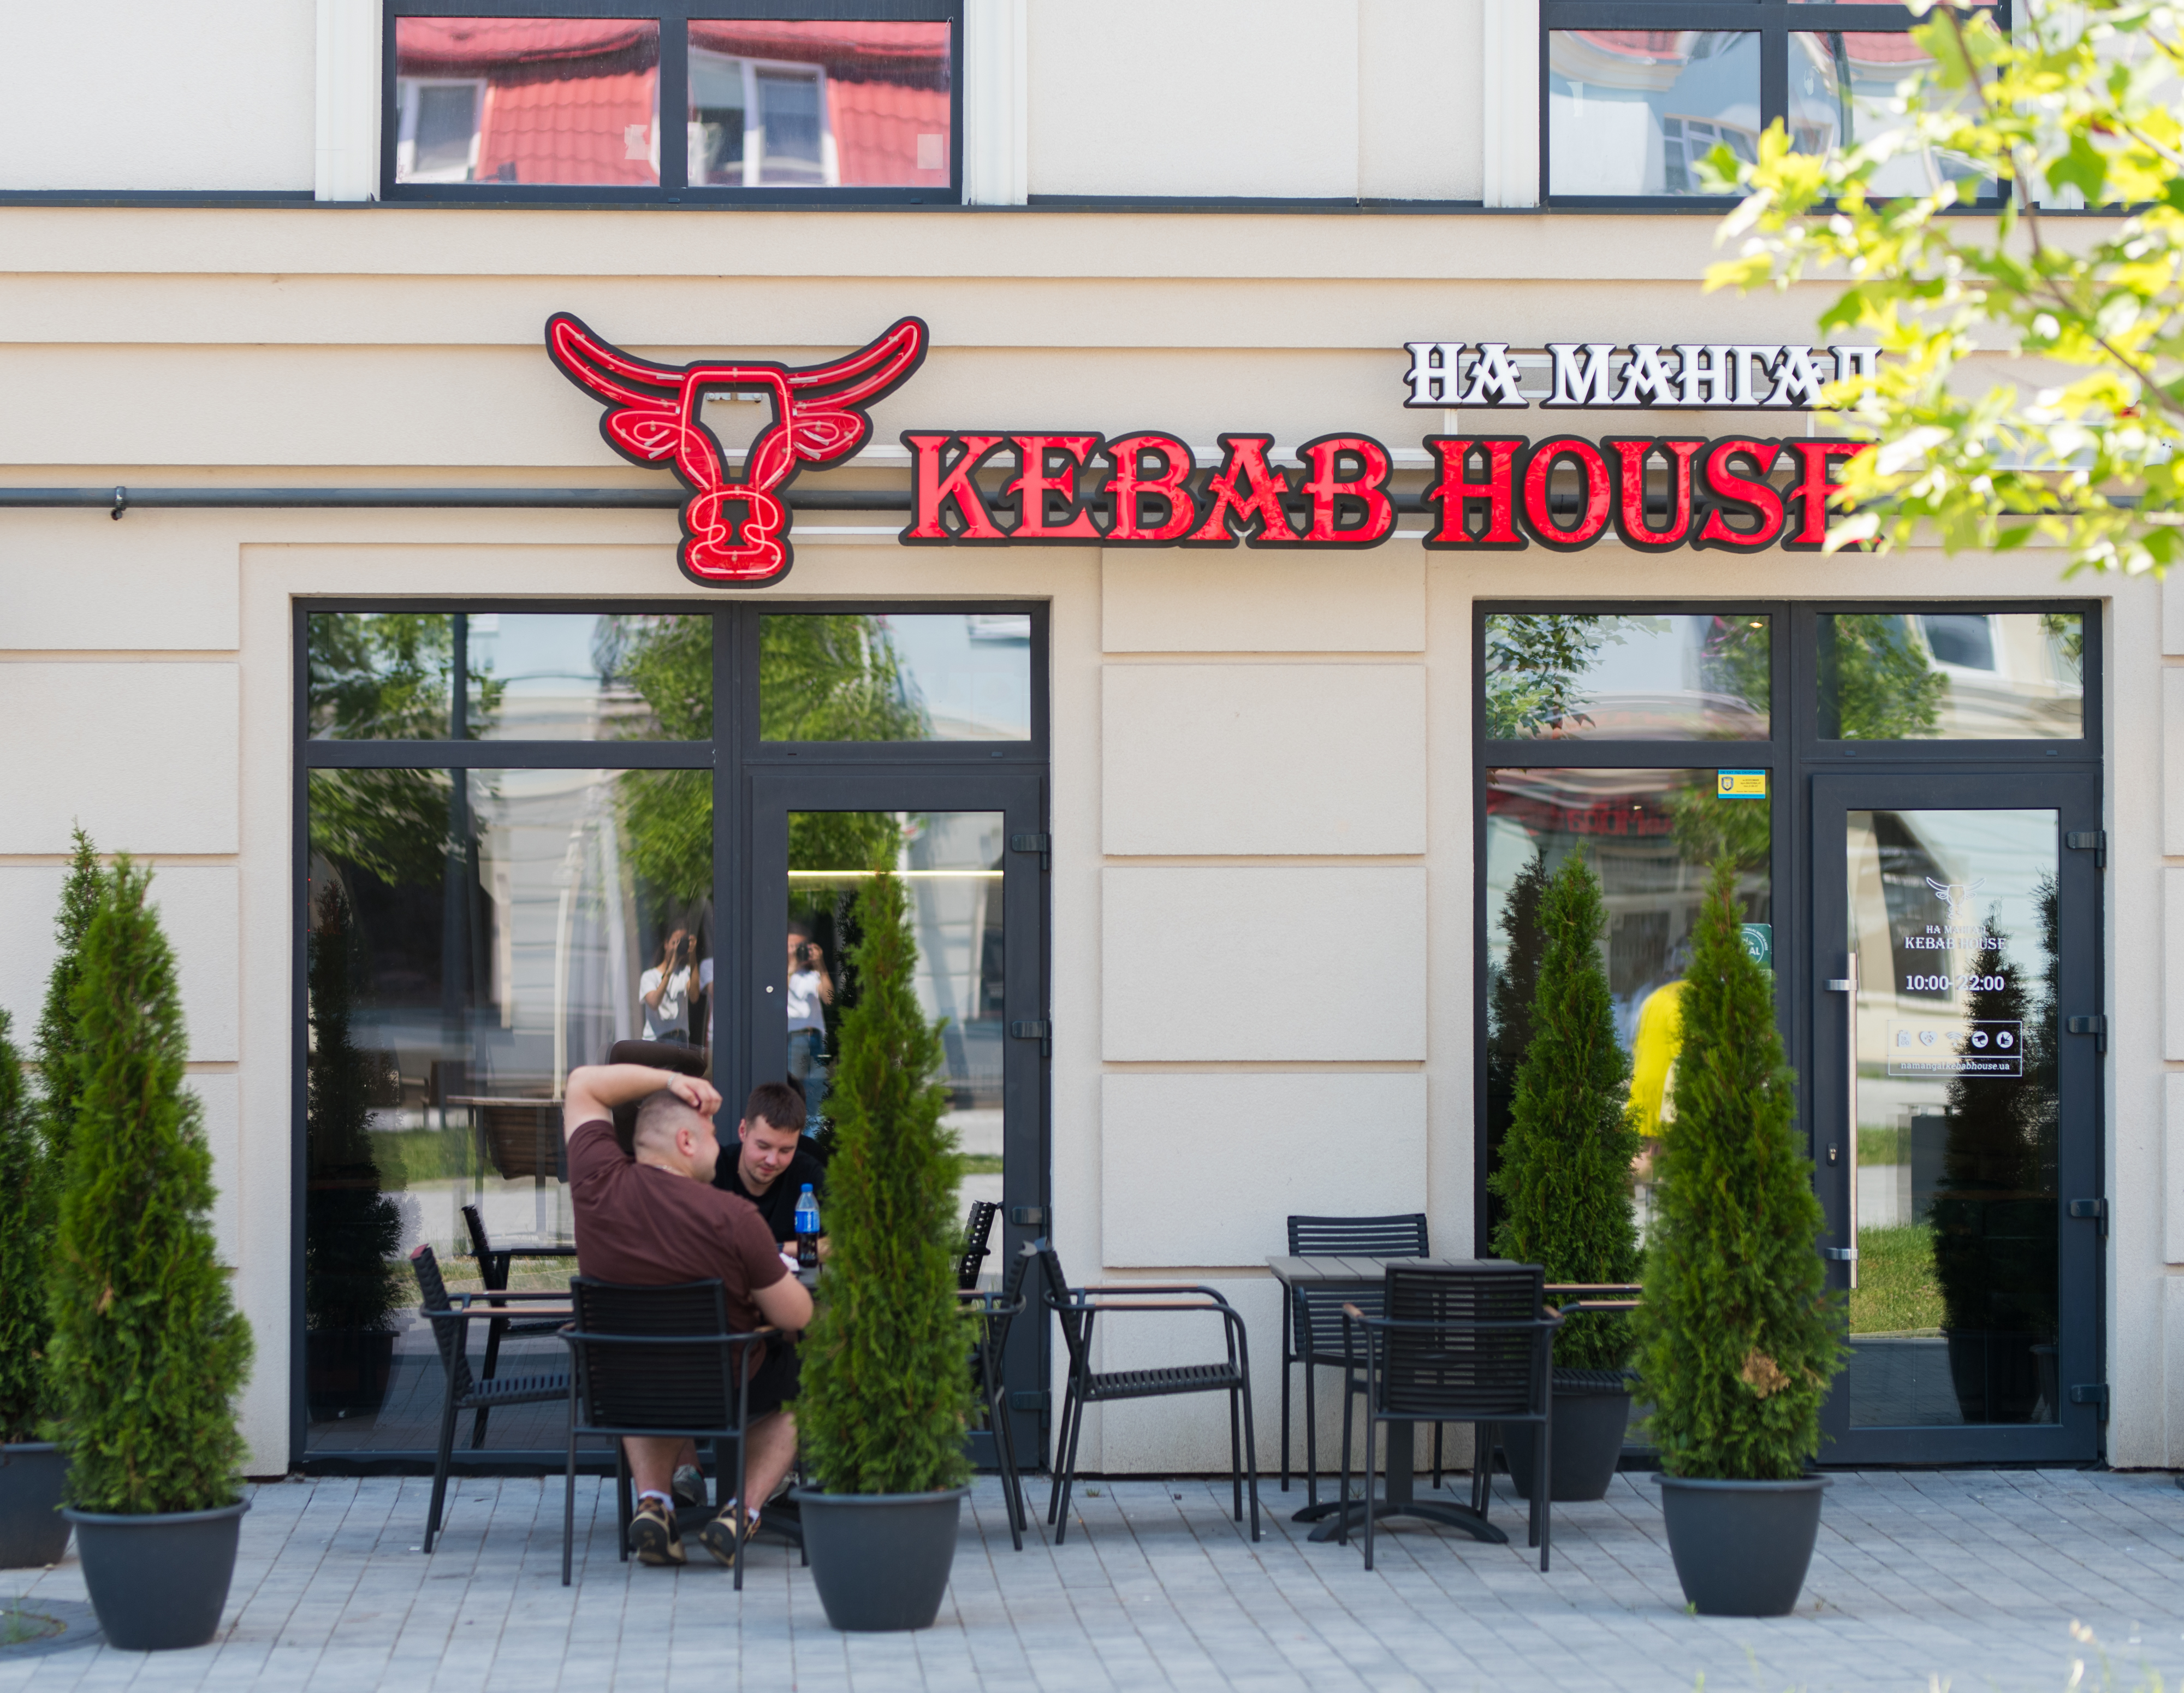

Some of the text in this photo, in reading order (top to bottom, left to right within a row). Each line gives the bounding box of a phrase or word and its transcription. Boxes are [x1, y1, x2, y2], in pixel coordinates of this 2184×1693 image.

[1405, 343, 1528, 406] НА
[906, 436, 1393, 542] KEBAB
[1926, 925, 1986, 934] НА МАНГАЛ
[1905, 937, 2007, 950] KEBAB HOUSE
[1900, 1062, 2010, 1072] namangalkebabhouse.ua
